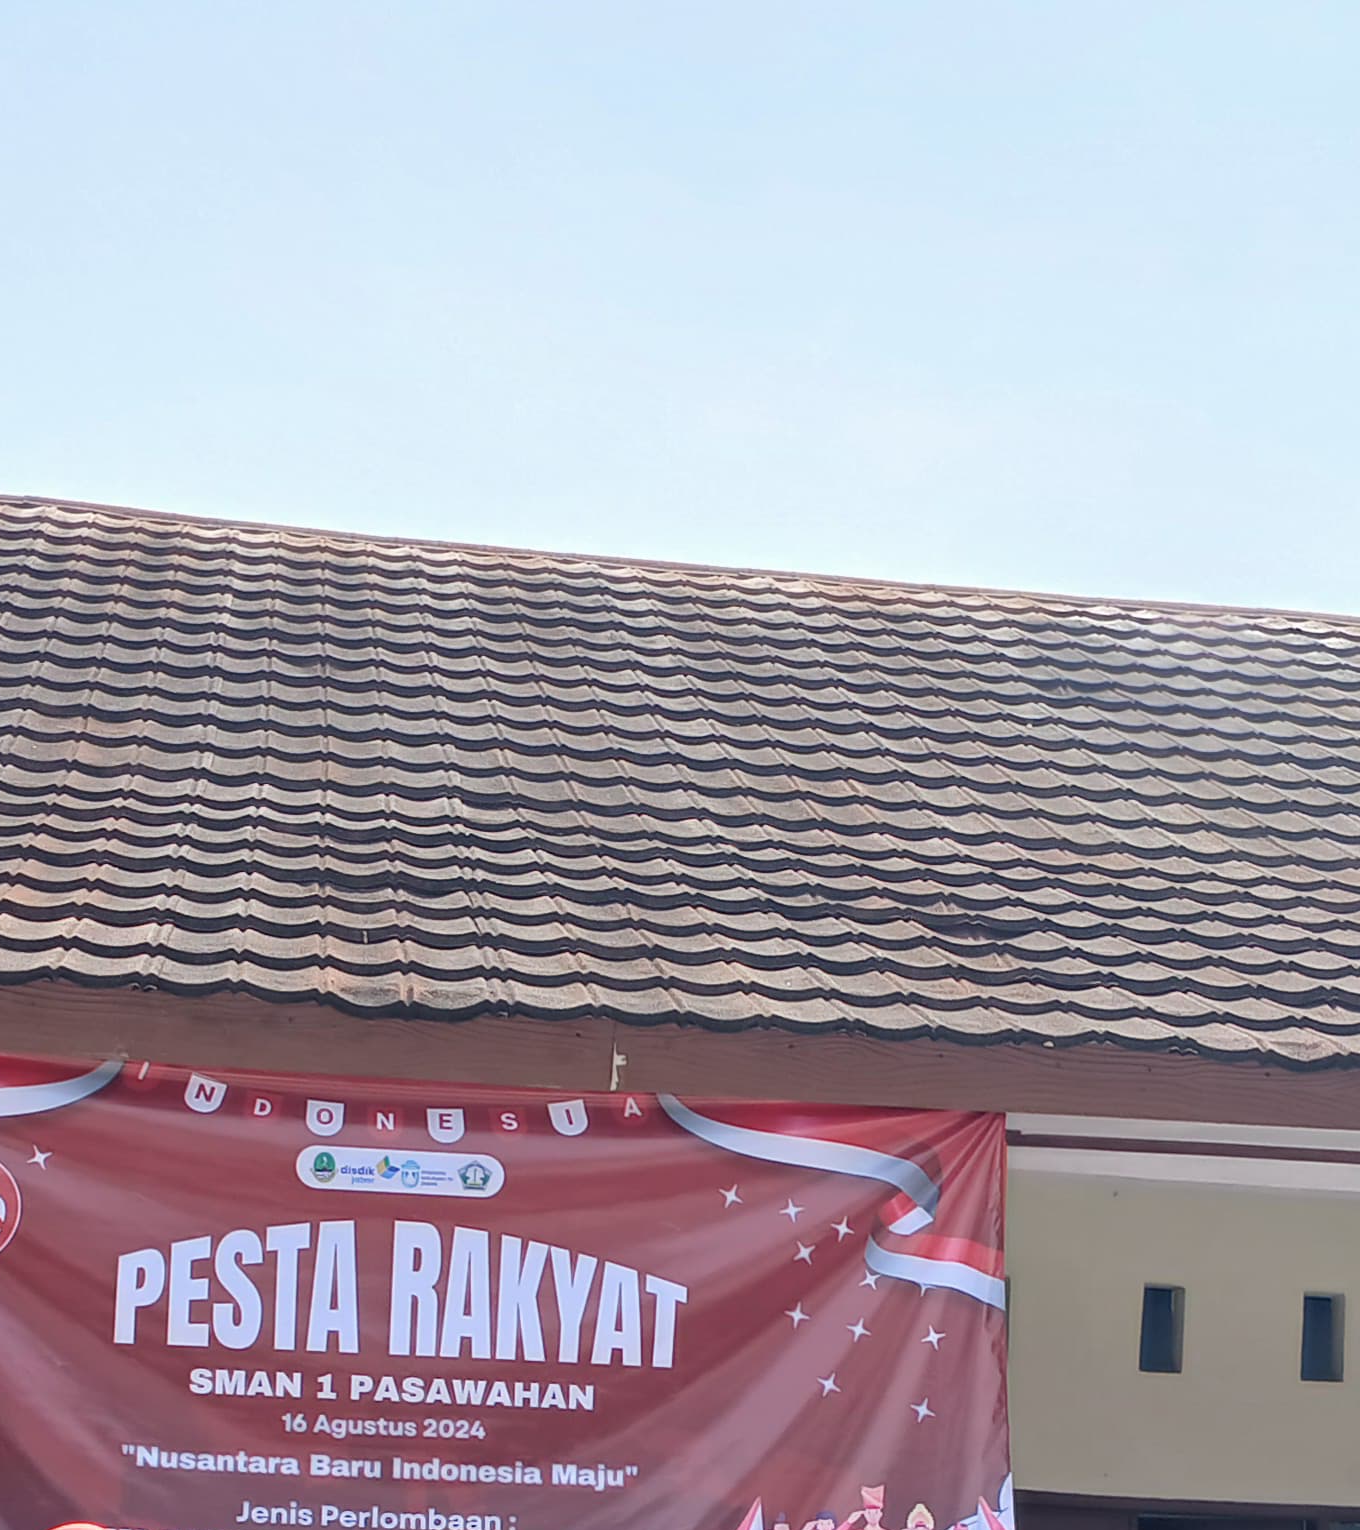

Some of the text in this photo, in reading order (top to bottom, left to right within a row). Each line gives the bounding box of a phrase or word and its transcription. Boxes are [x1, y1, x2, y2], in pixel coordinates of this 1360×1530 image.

[340, 1165, 375, 1176] disdik
[113, 1219, 688, 1368] PESTA RAKYAT
[189, 1368, 595, 1411] SMAN 1 PASAWAHAN
[281, 1413, 486, 1440] 16 Agustus 2024
[121, 1444, 638, 1492] "Nusantara Baru Indonesia Maju"
[236, 1501, 313, 1527] Jenis
